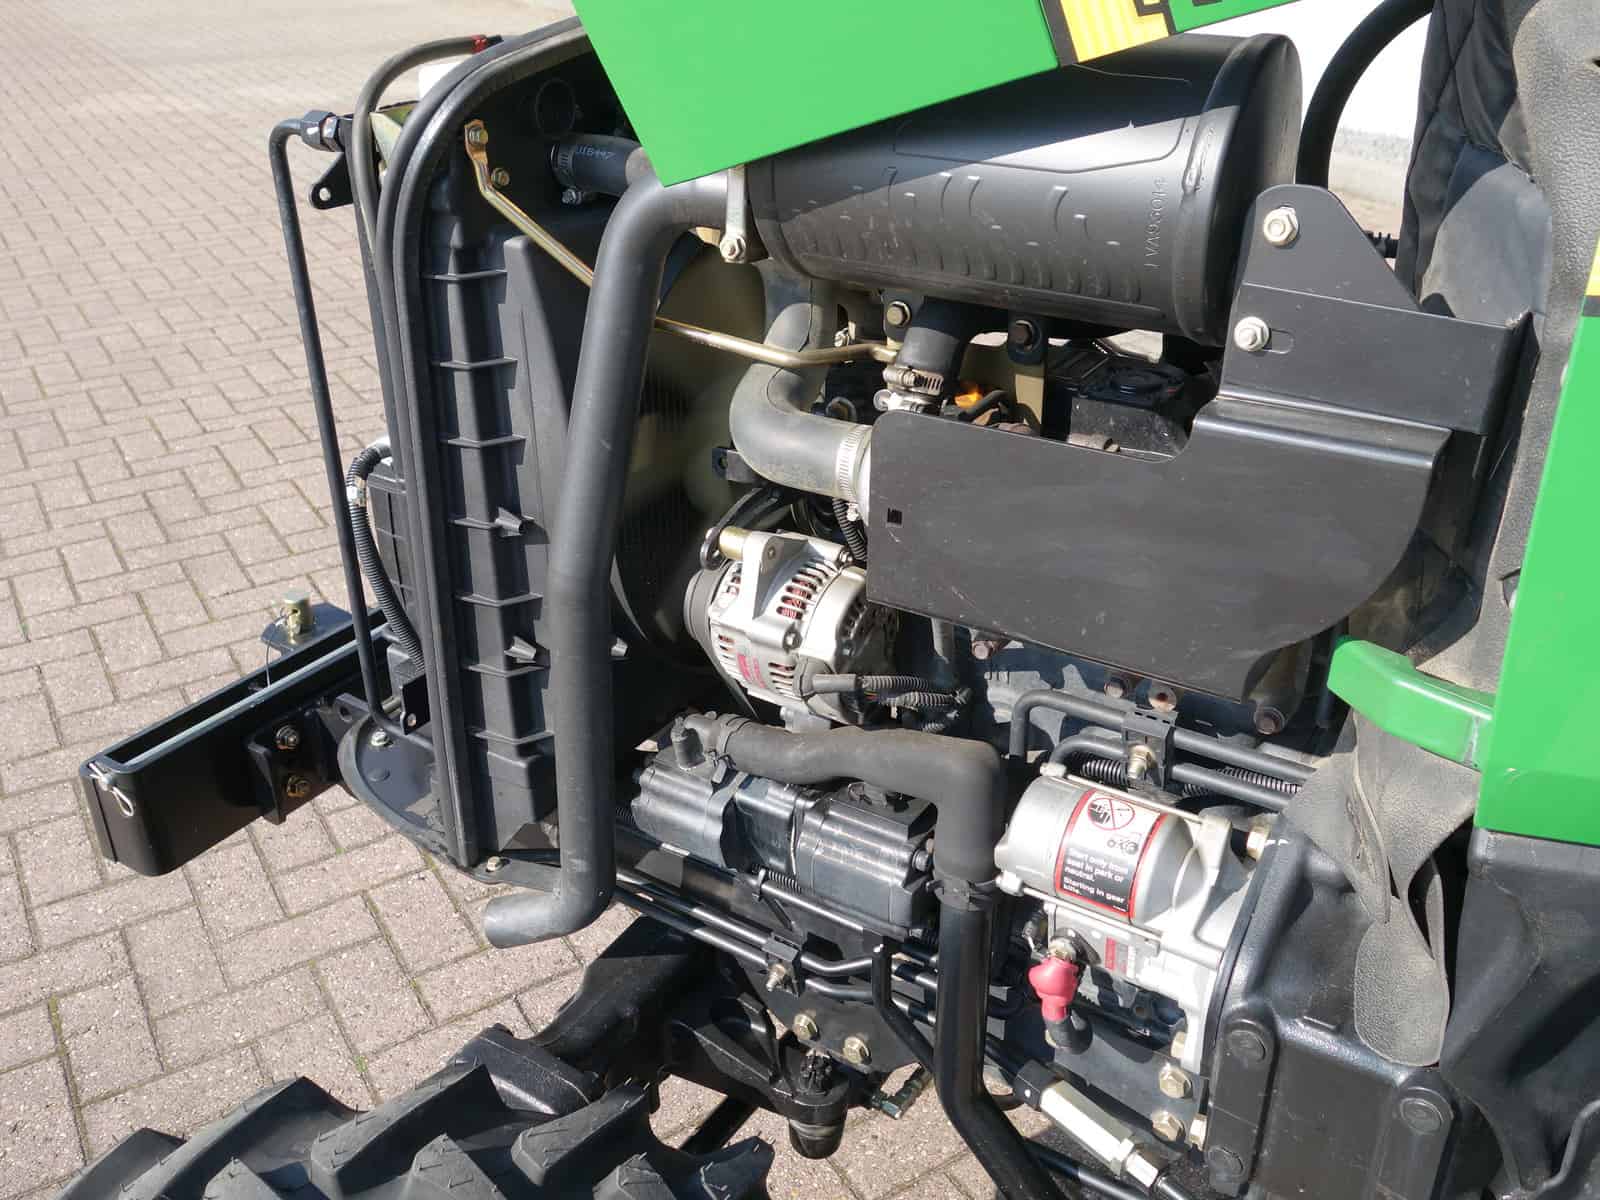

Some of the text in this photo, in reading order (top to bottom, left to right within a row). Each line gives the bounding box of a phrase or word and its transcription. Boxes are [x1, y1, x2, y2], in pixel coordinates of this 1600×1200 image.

[1094, 868, 1114, 879] park
[1063, 876, 1126, 903] Starting in gear
